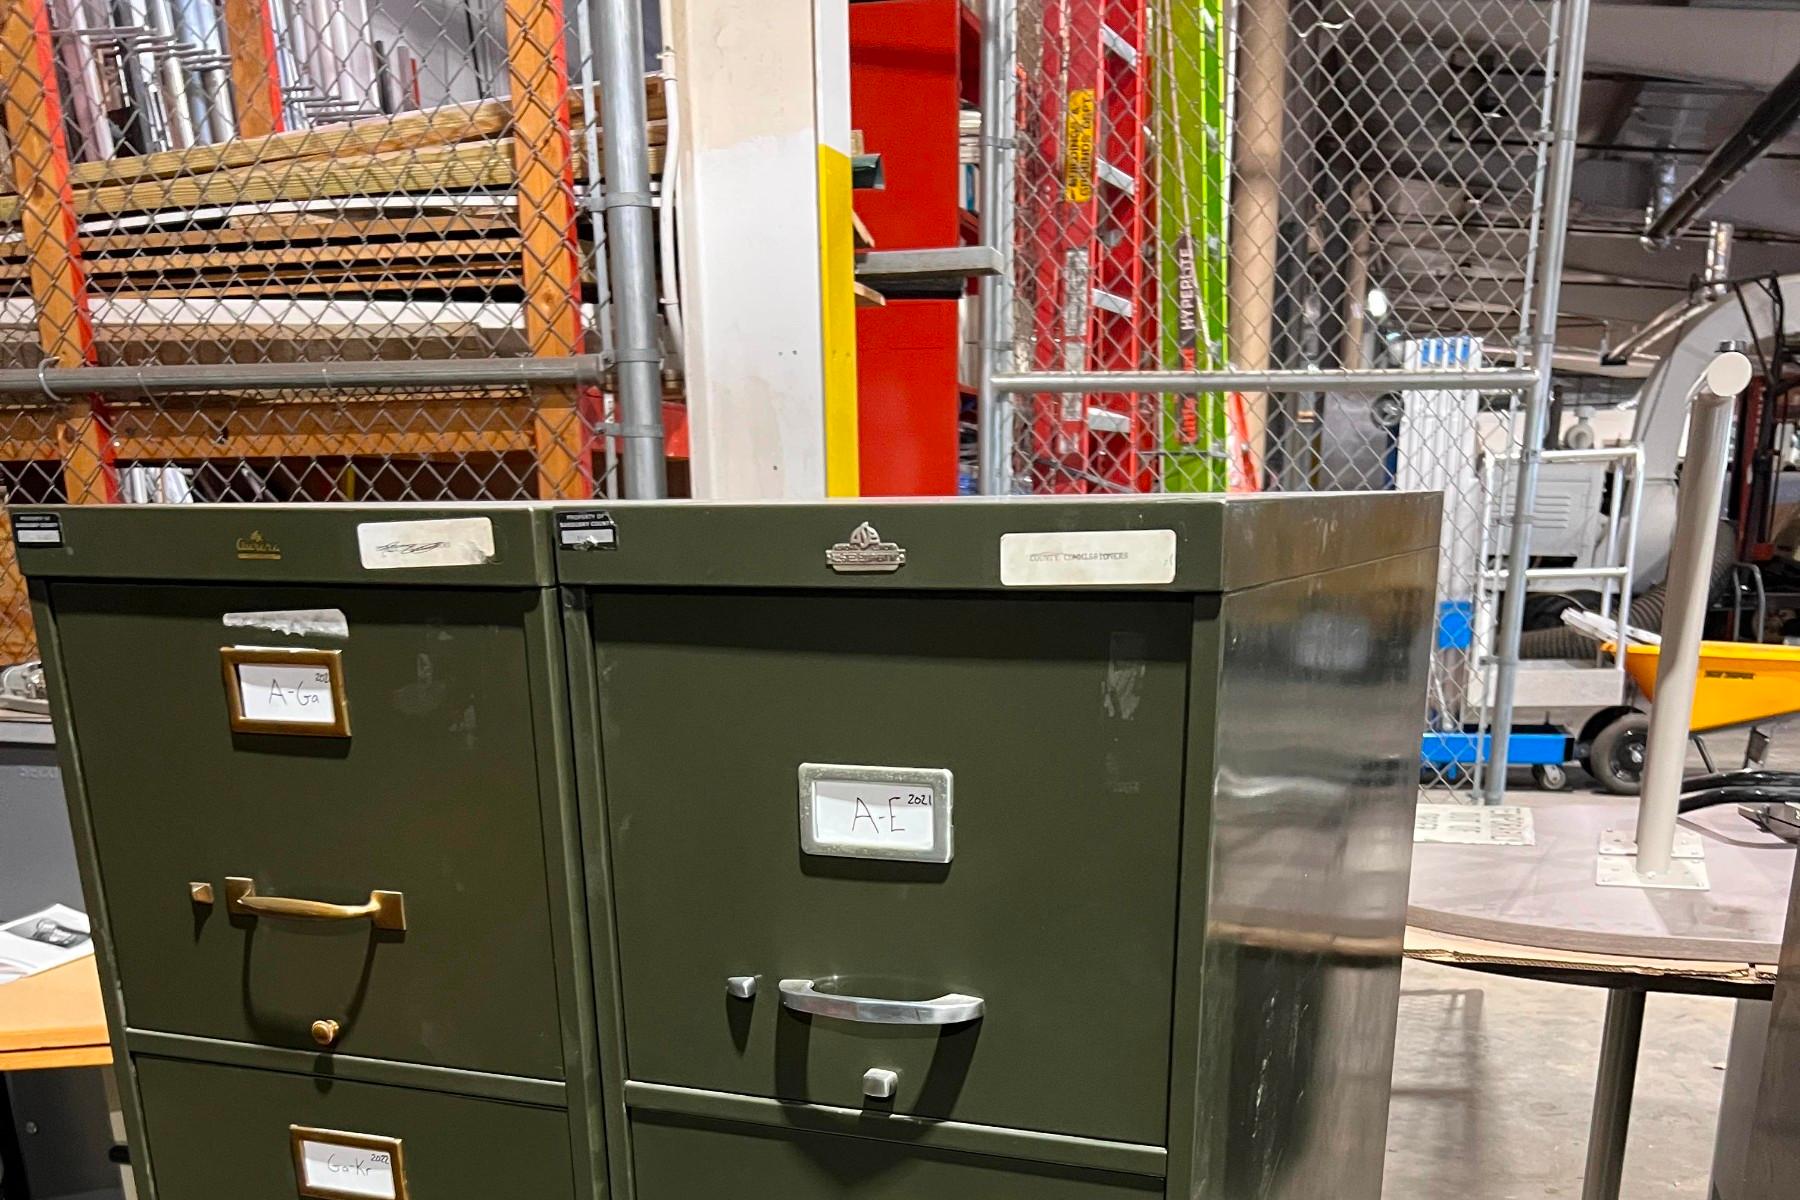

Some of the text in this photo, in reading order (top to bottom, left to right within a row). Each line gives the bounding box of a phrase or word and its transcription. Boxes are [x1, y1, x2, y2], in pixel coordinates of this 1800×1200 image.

[1179, 248, 1196, 331] HYPERLITE
[268, 678, 320, 706] A-Ga
[852, 794, 932, 834] A-E 2021
